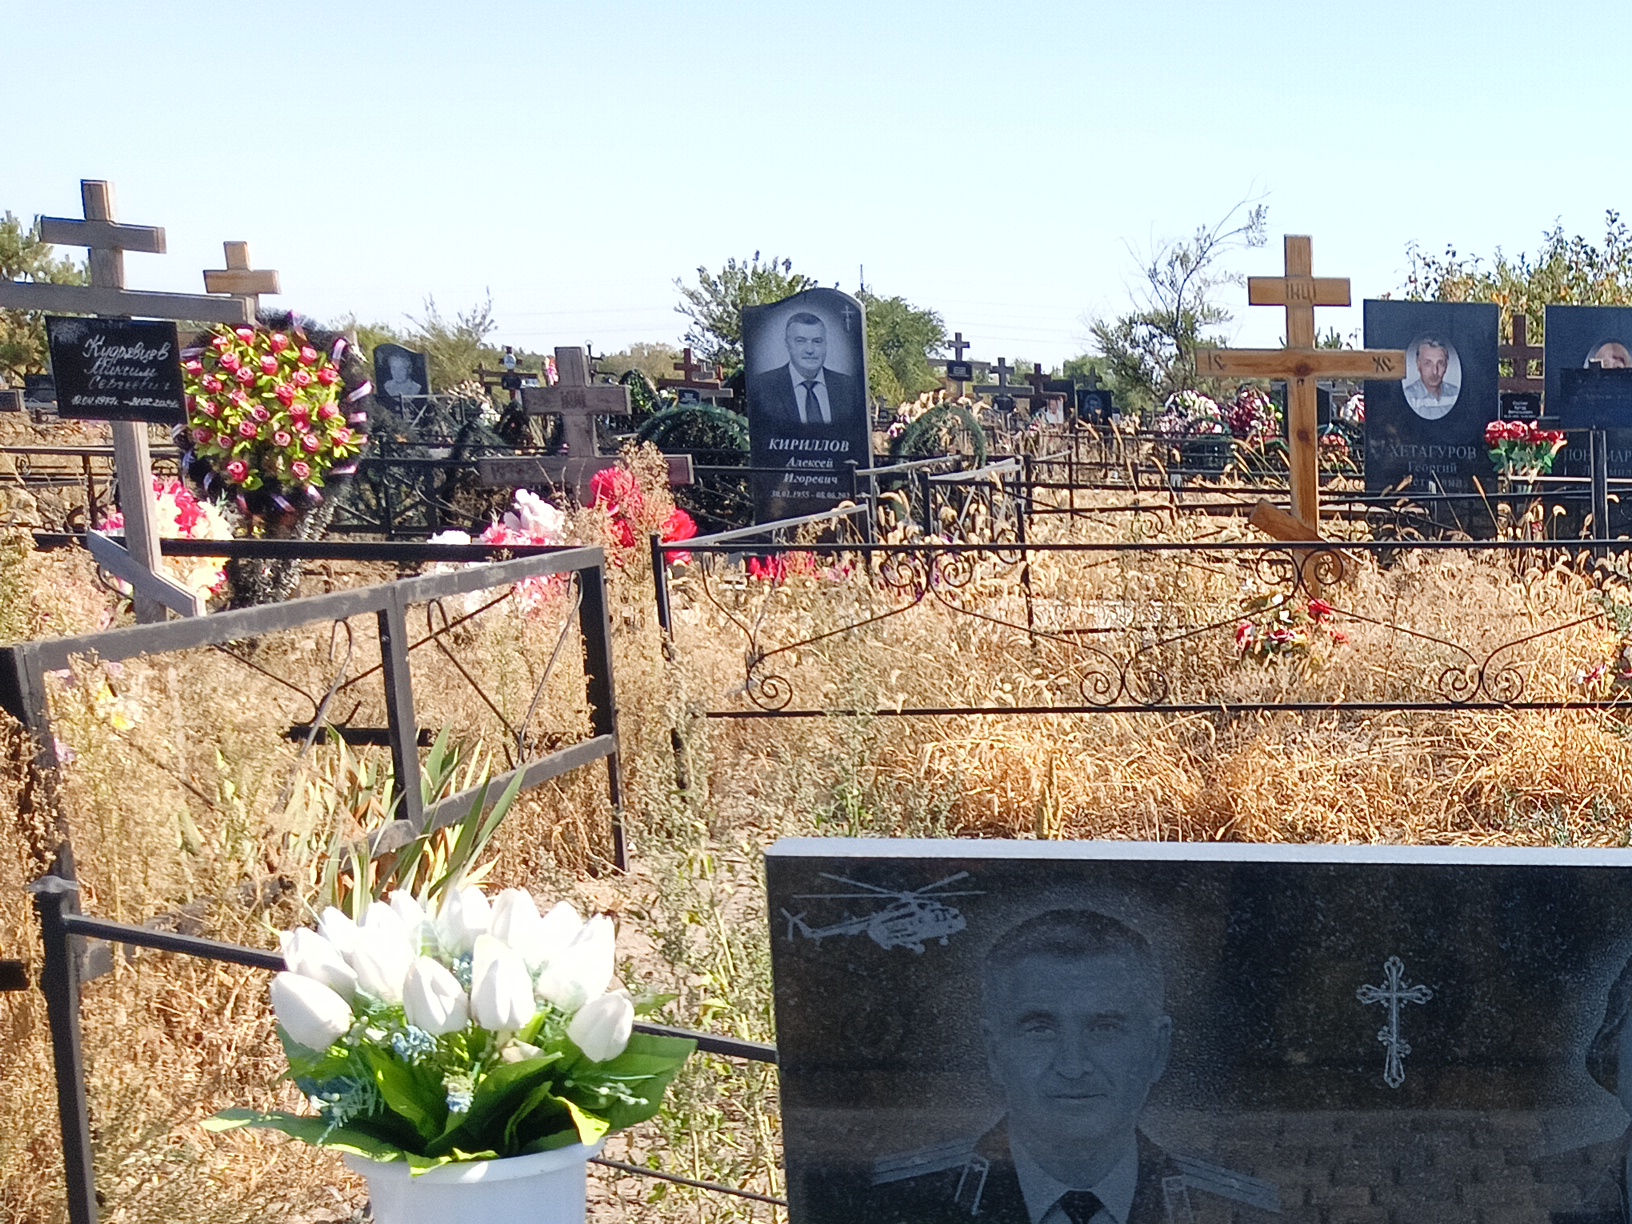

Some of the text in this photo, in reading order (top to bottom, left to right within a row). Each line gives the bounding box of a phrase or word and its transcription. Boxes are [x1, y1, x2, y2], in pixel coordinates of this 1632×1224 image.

[768, 438, 850, 452] КИРИЛЛОВ
[1391, 444, 1477, 460] ХЕТАГУРОВ
[785, 456, 834, 468] Алексей
[1408, 461, 1457, 475] Георгий
[783, 472, 838, 486] Игоревич
